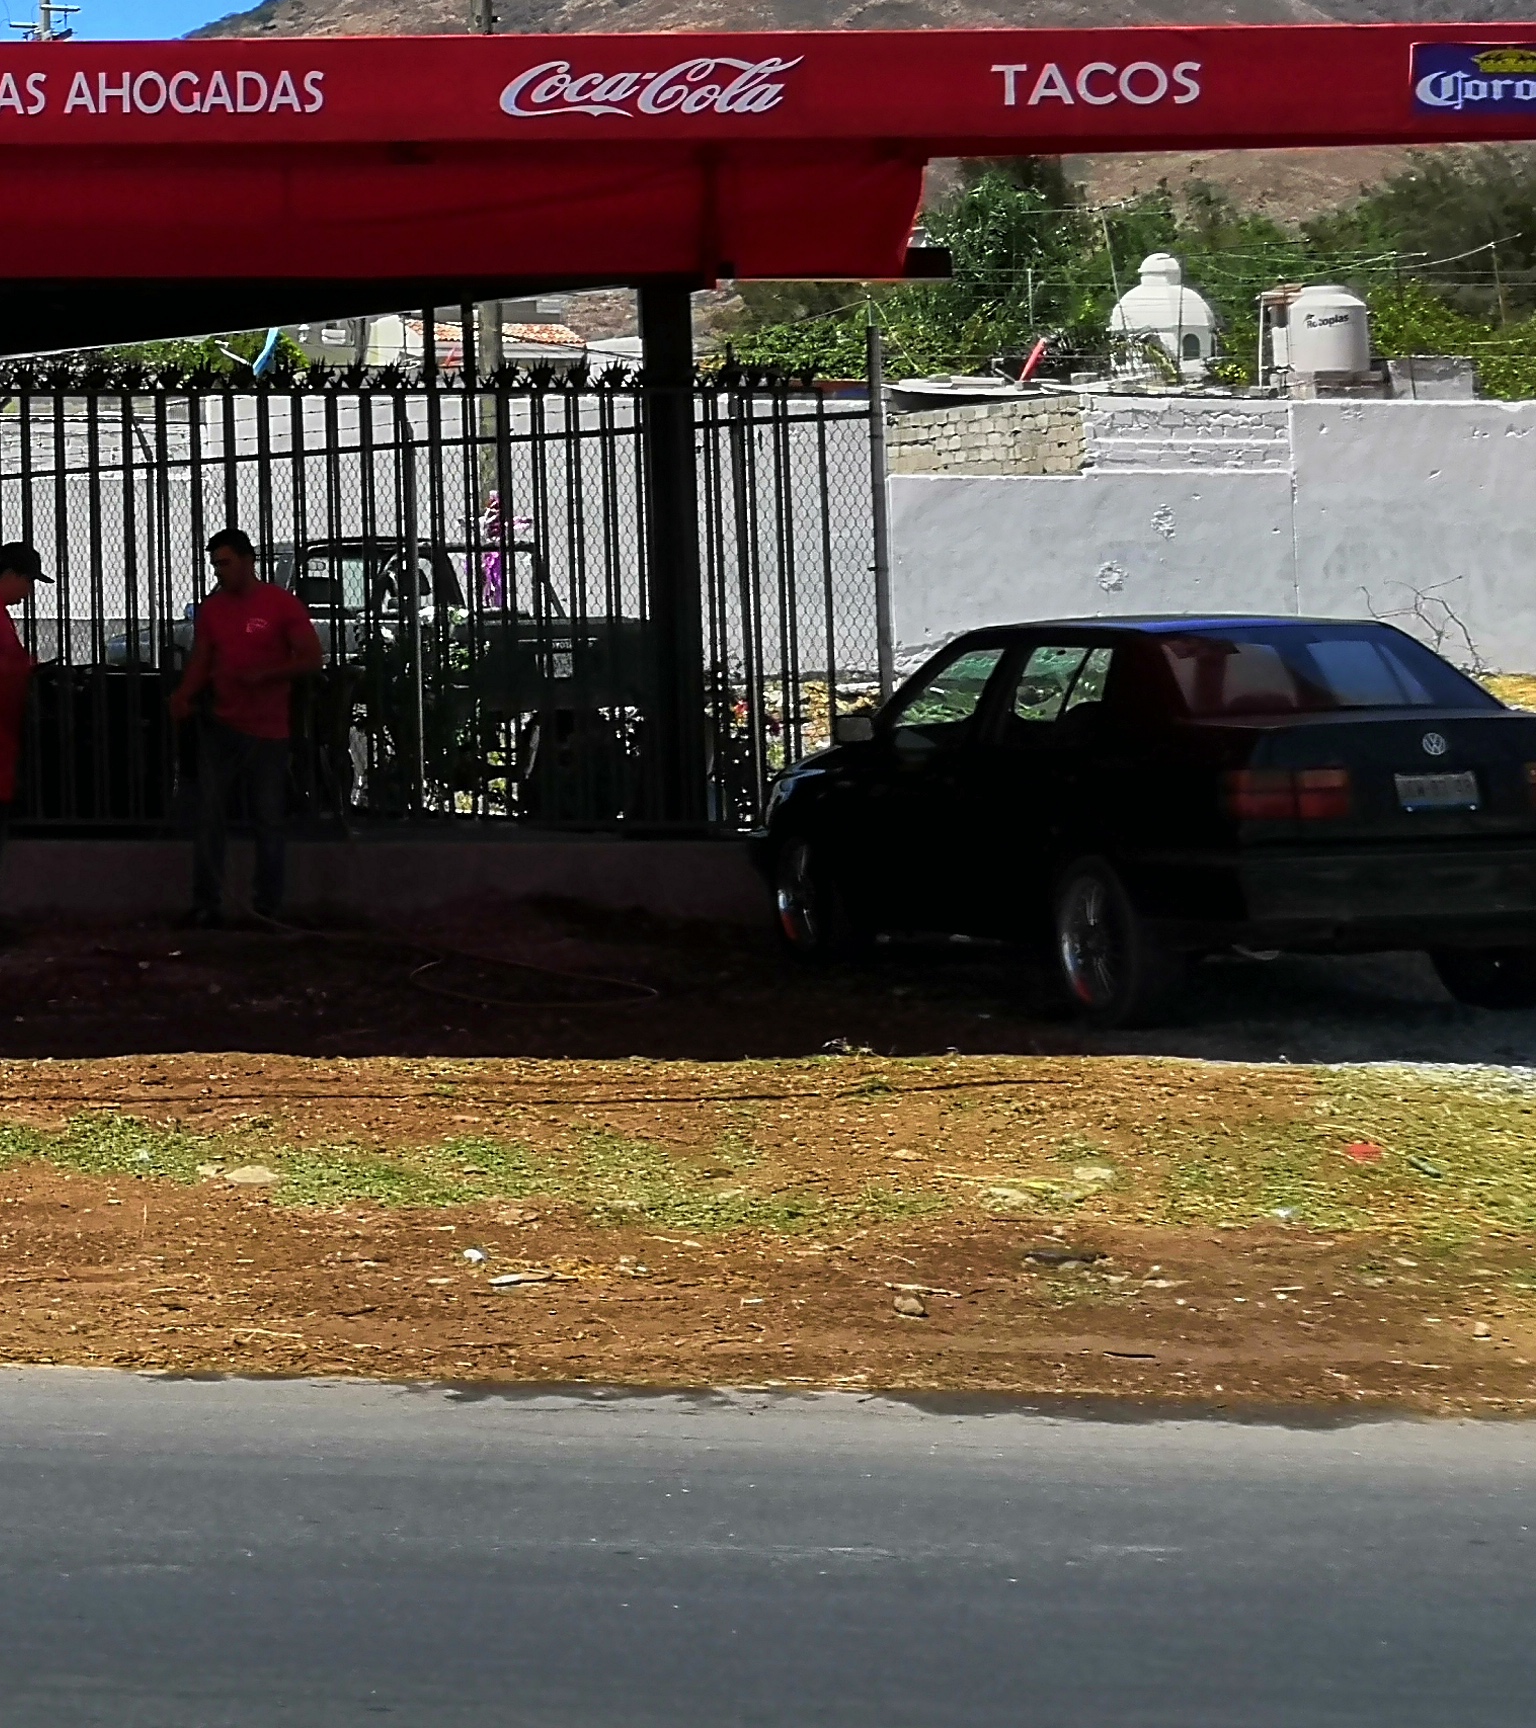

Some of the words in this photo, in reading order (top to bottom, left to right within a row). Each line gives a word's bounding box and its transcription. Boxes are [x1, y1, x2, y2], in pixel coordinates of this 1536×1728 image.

[63, 70, 324, 114] AHOGADAS
[499, 55, 804, 117] Coca-Cola
[990, 61, 1202, 106] TACOS
